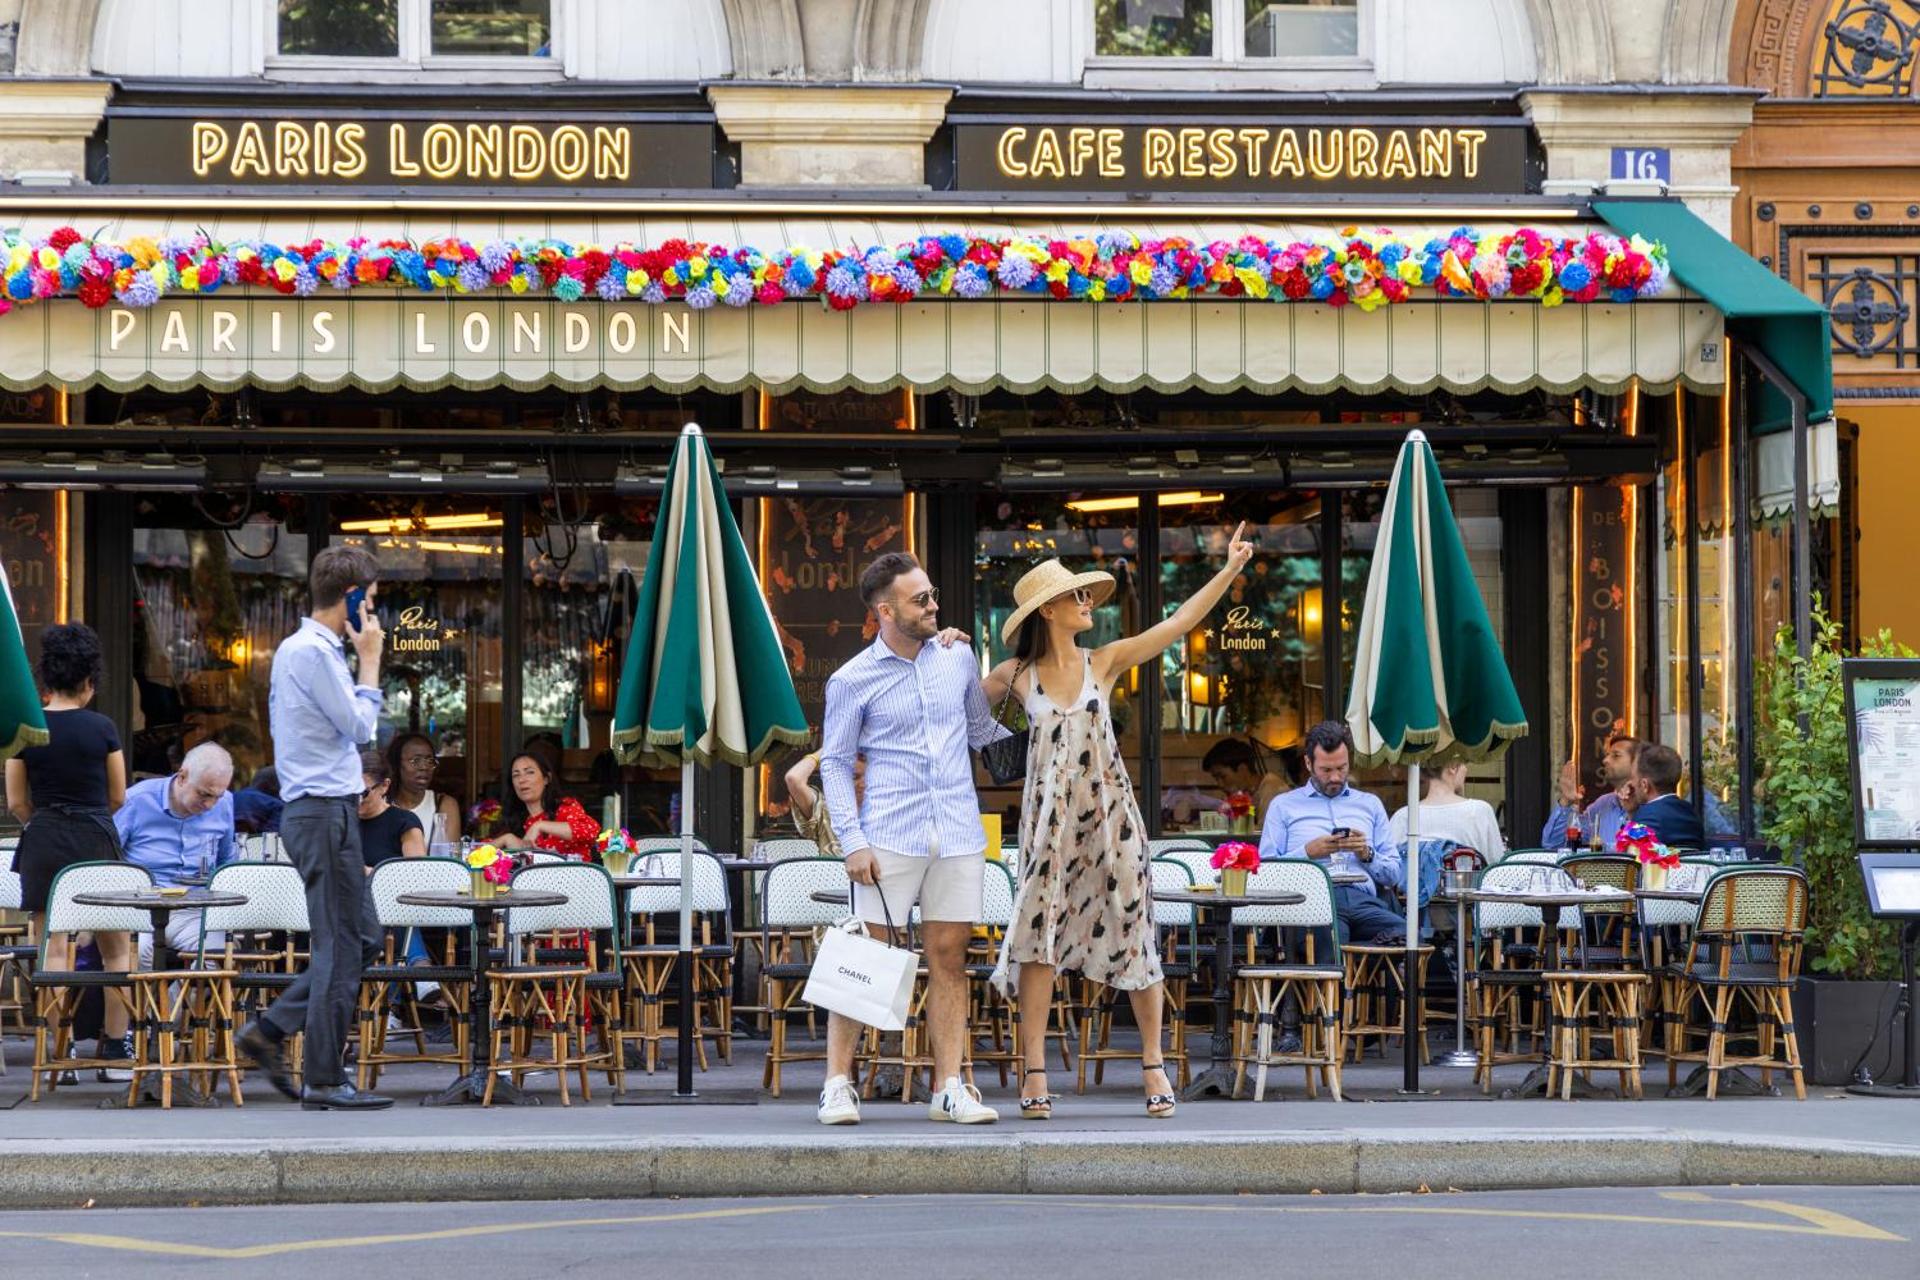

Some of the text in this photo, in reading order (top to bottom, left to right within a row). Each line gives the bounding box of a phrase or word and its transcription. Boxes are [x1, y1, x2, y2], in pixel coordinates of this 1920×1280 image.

[192, 121, 632, 181] PARIS LONDON
[997, 126, 1488, 180] CAFE RESTAURANT
[1625, 150, 1657, 179] 16
[110, 309, 690, 354] PARIS LONDON
[1592, 511, 1616, 526] DE
[782, 547, 870, 590] Lond
[393, 606, 438, 631] Paris
[1221, 605, 1264, 631] Paris
[393, 632, 440, 651] London
[1220, 632, 1266, 650] London
[1873, 698, 1911, 707] LONDON
[1878, 687, 1905, 697] PARIS
[837, 966, 872, 985] CHANEL
